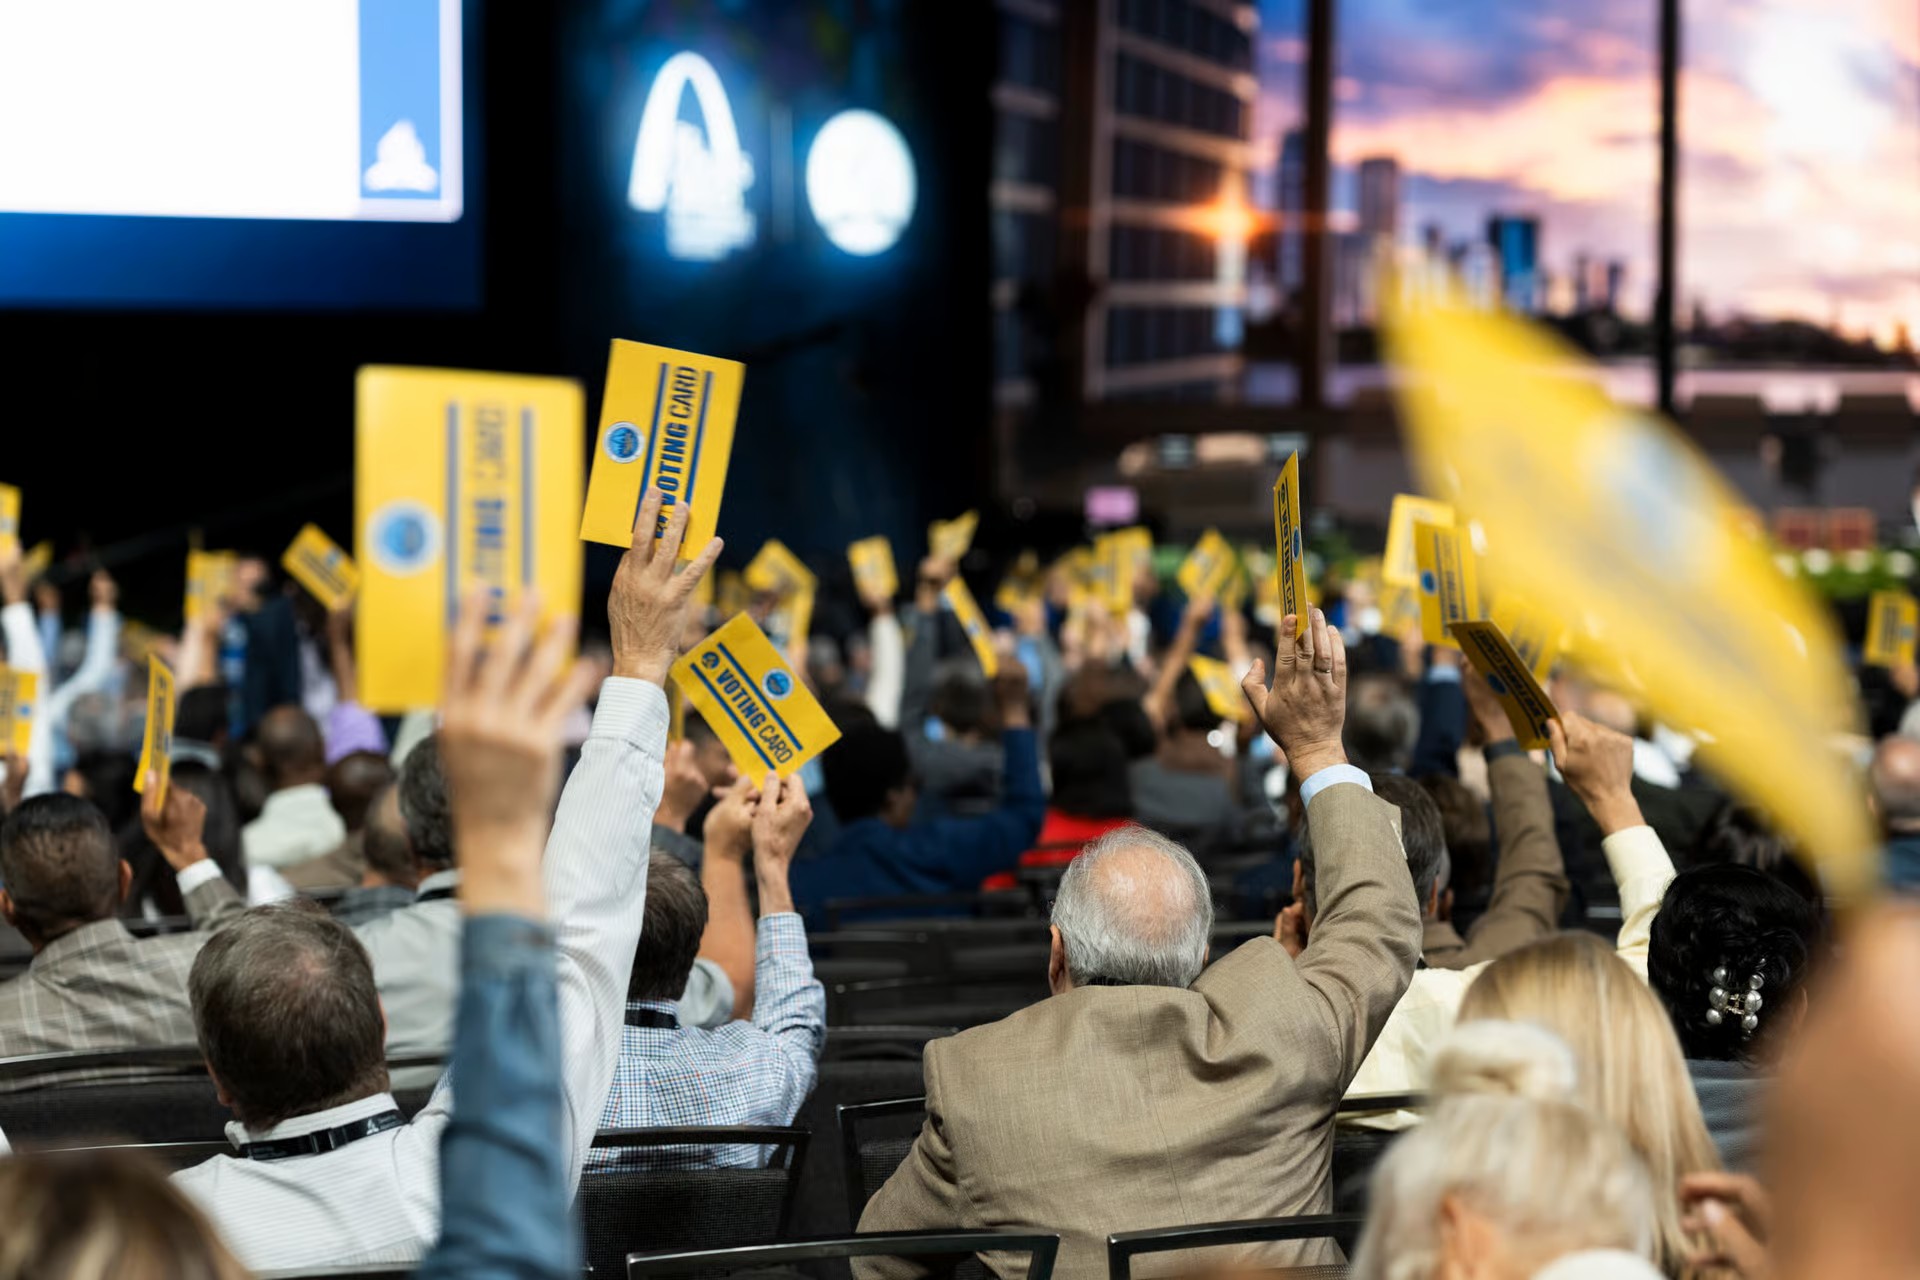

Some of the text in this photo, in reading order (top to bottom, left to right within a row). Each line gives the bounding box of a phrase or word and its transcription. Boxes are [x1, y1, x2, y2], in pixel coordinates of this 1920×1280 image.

[656, 365, 699, 506] VOTING CARD
[1281, 510, 1291, 585] VOTING
[716, 669, 793, 764] VOTING CARD
